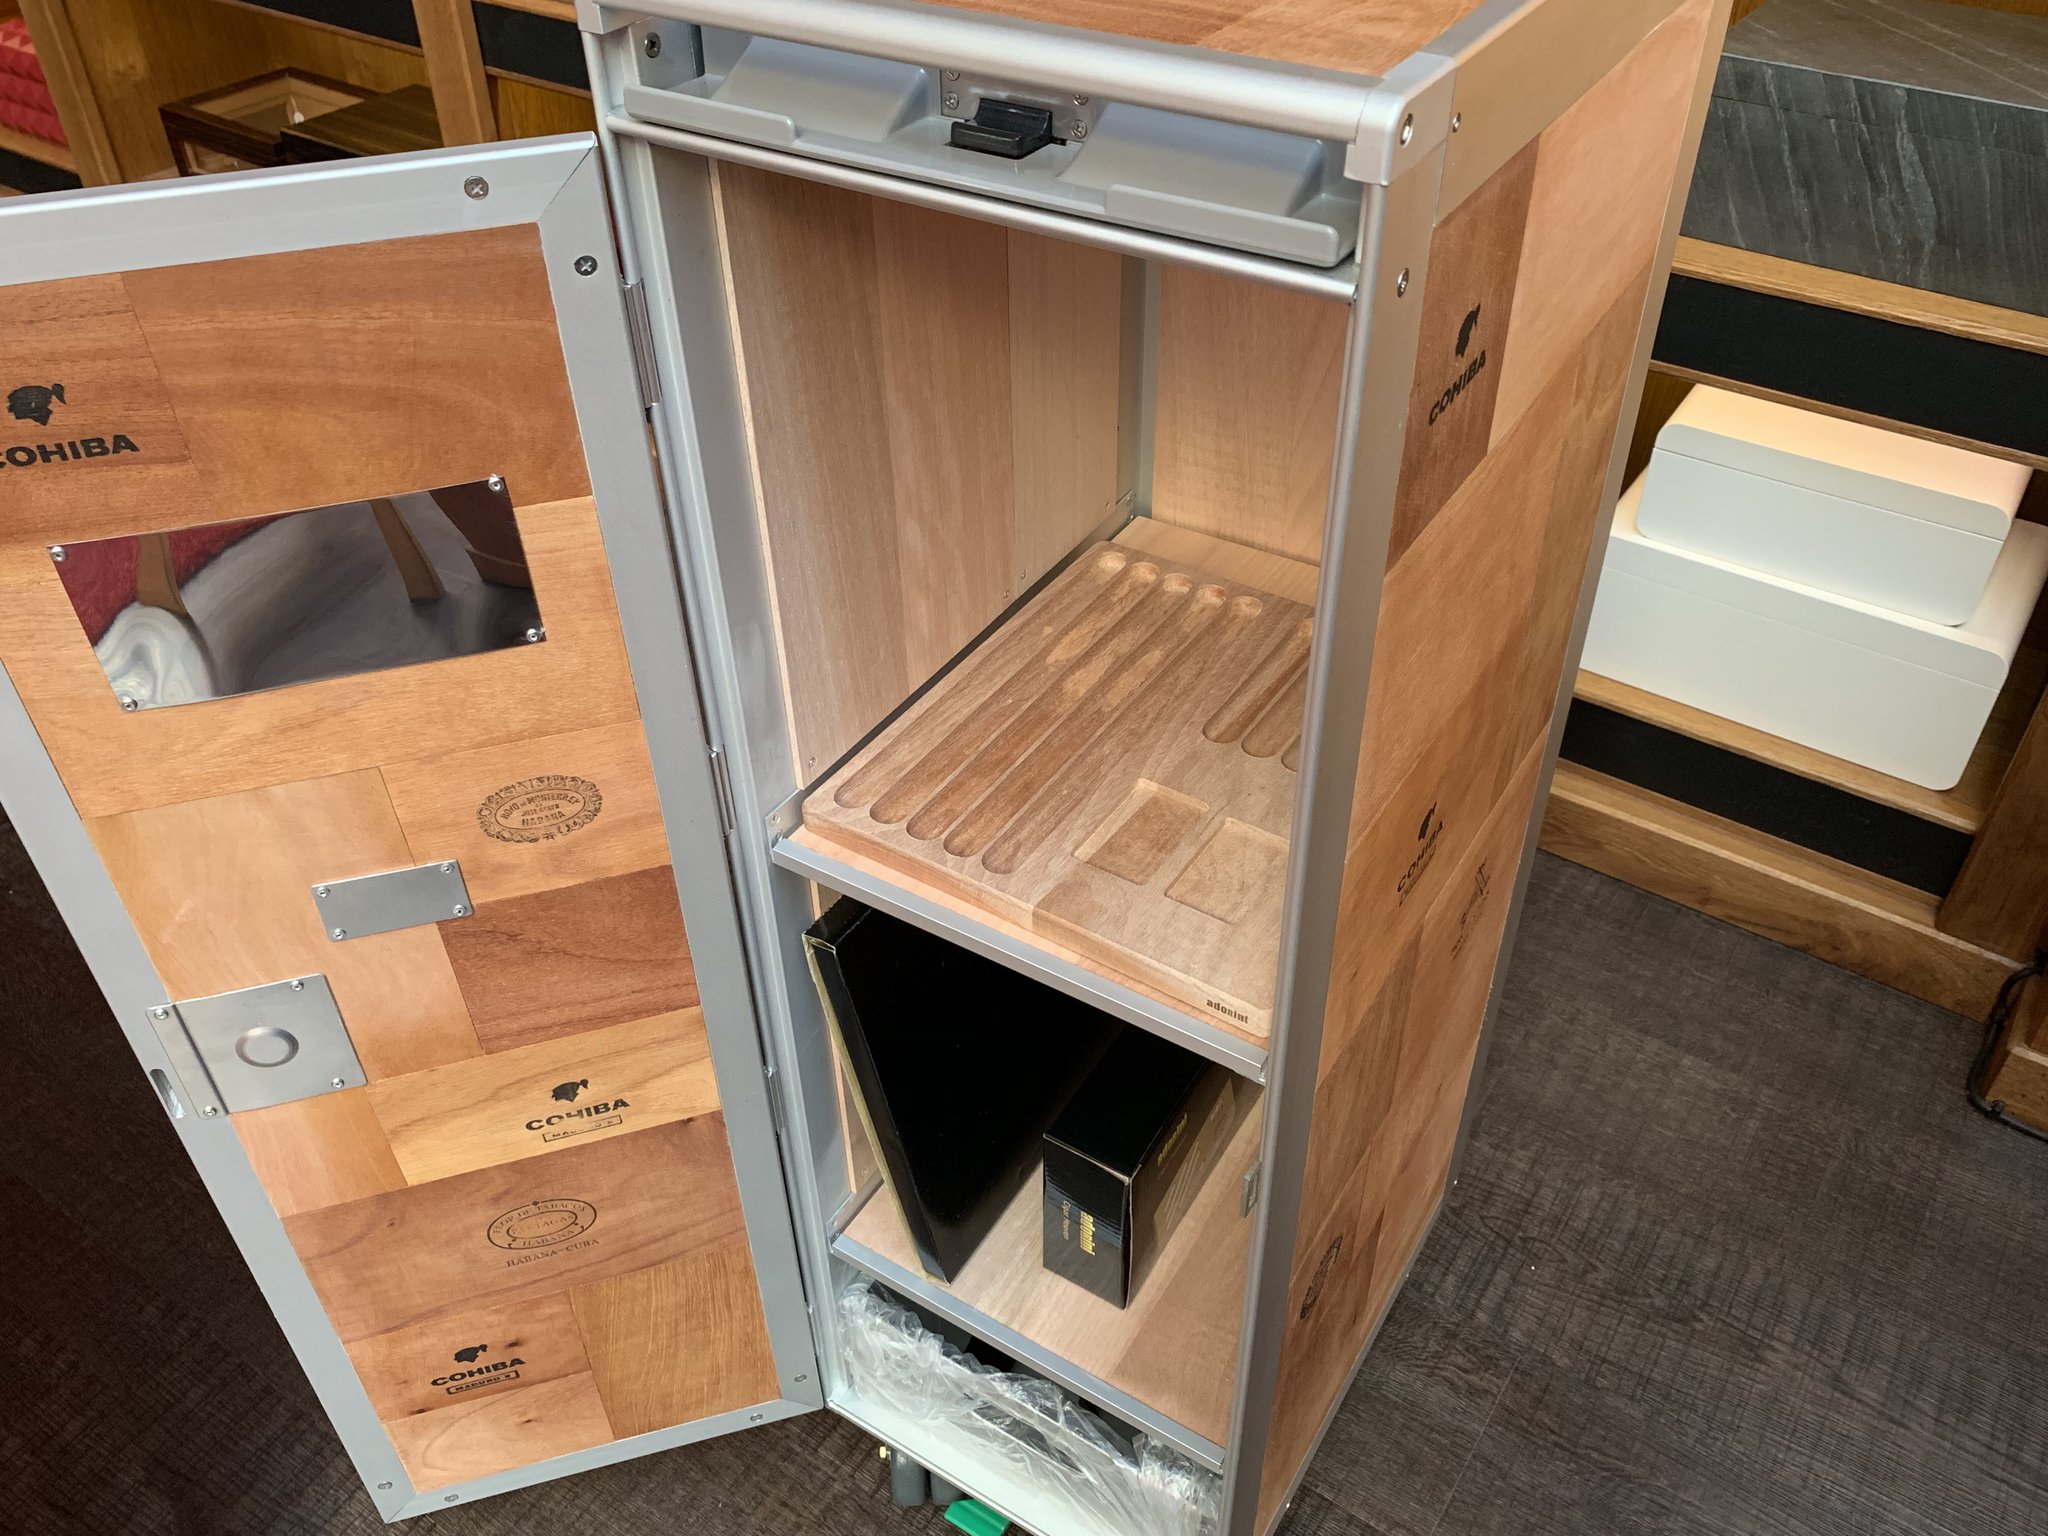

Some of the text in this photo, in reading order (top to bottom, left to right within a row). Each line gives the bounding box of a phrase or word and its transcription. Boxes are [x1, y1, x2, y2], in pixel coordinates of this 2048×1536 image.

[1428, 350, 1487, 426] COHIBA
[0, 434, 140, 469] OHIBA
[521, 810, 566, 826] HABANA
[525, 1098, 631, 1131] COHIBA
[1079, 1210, 1096, 1256] adorini
[431, 1358, 526, 1386] COHIBA
